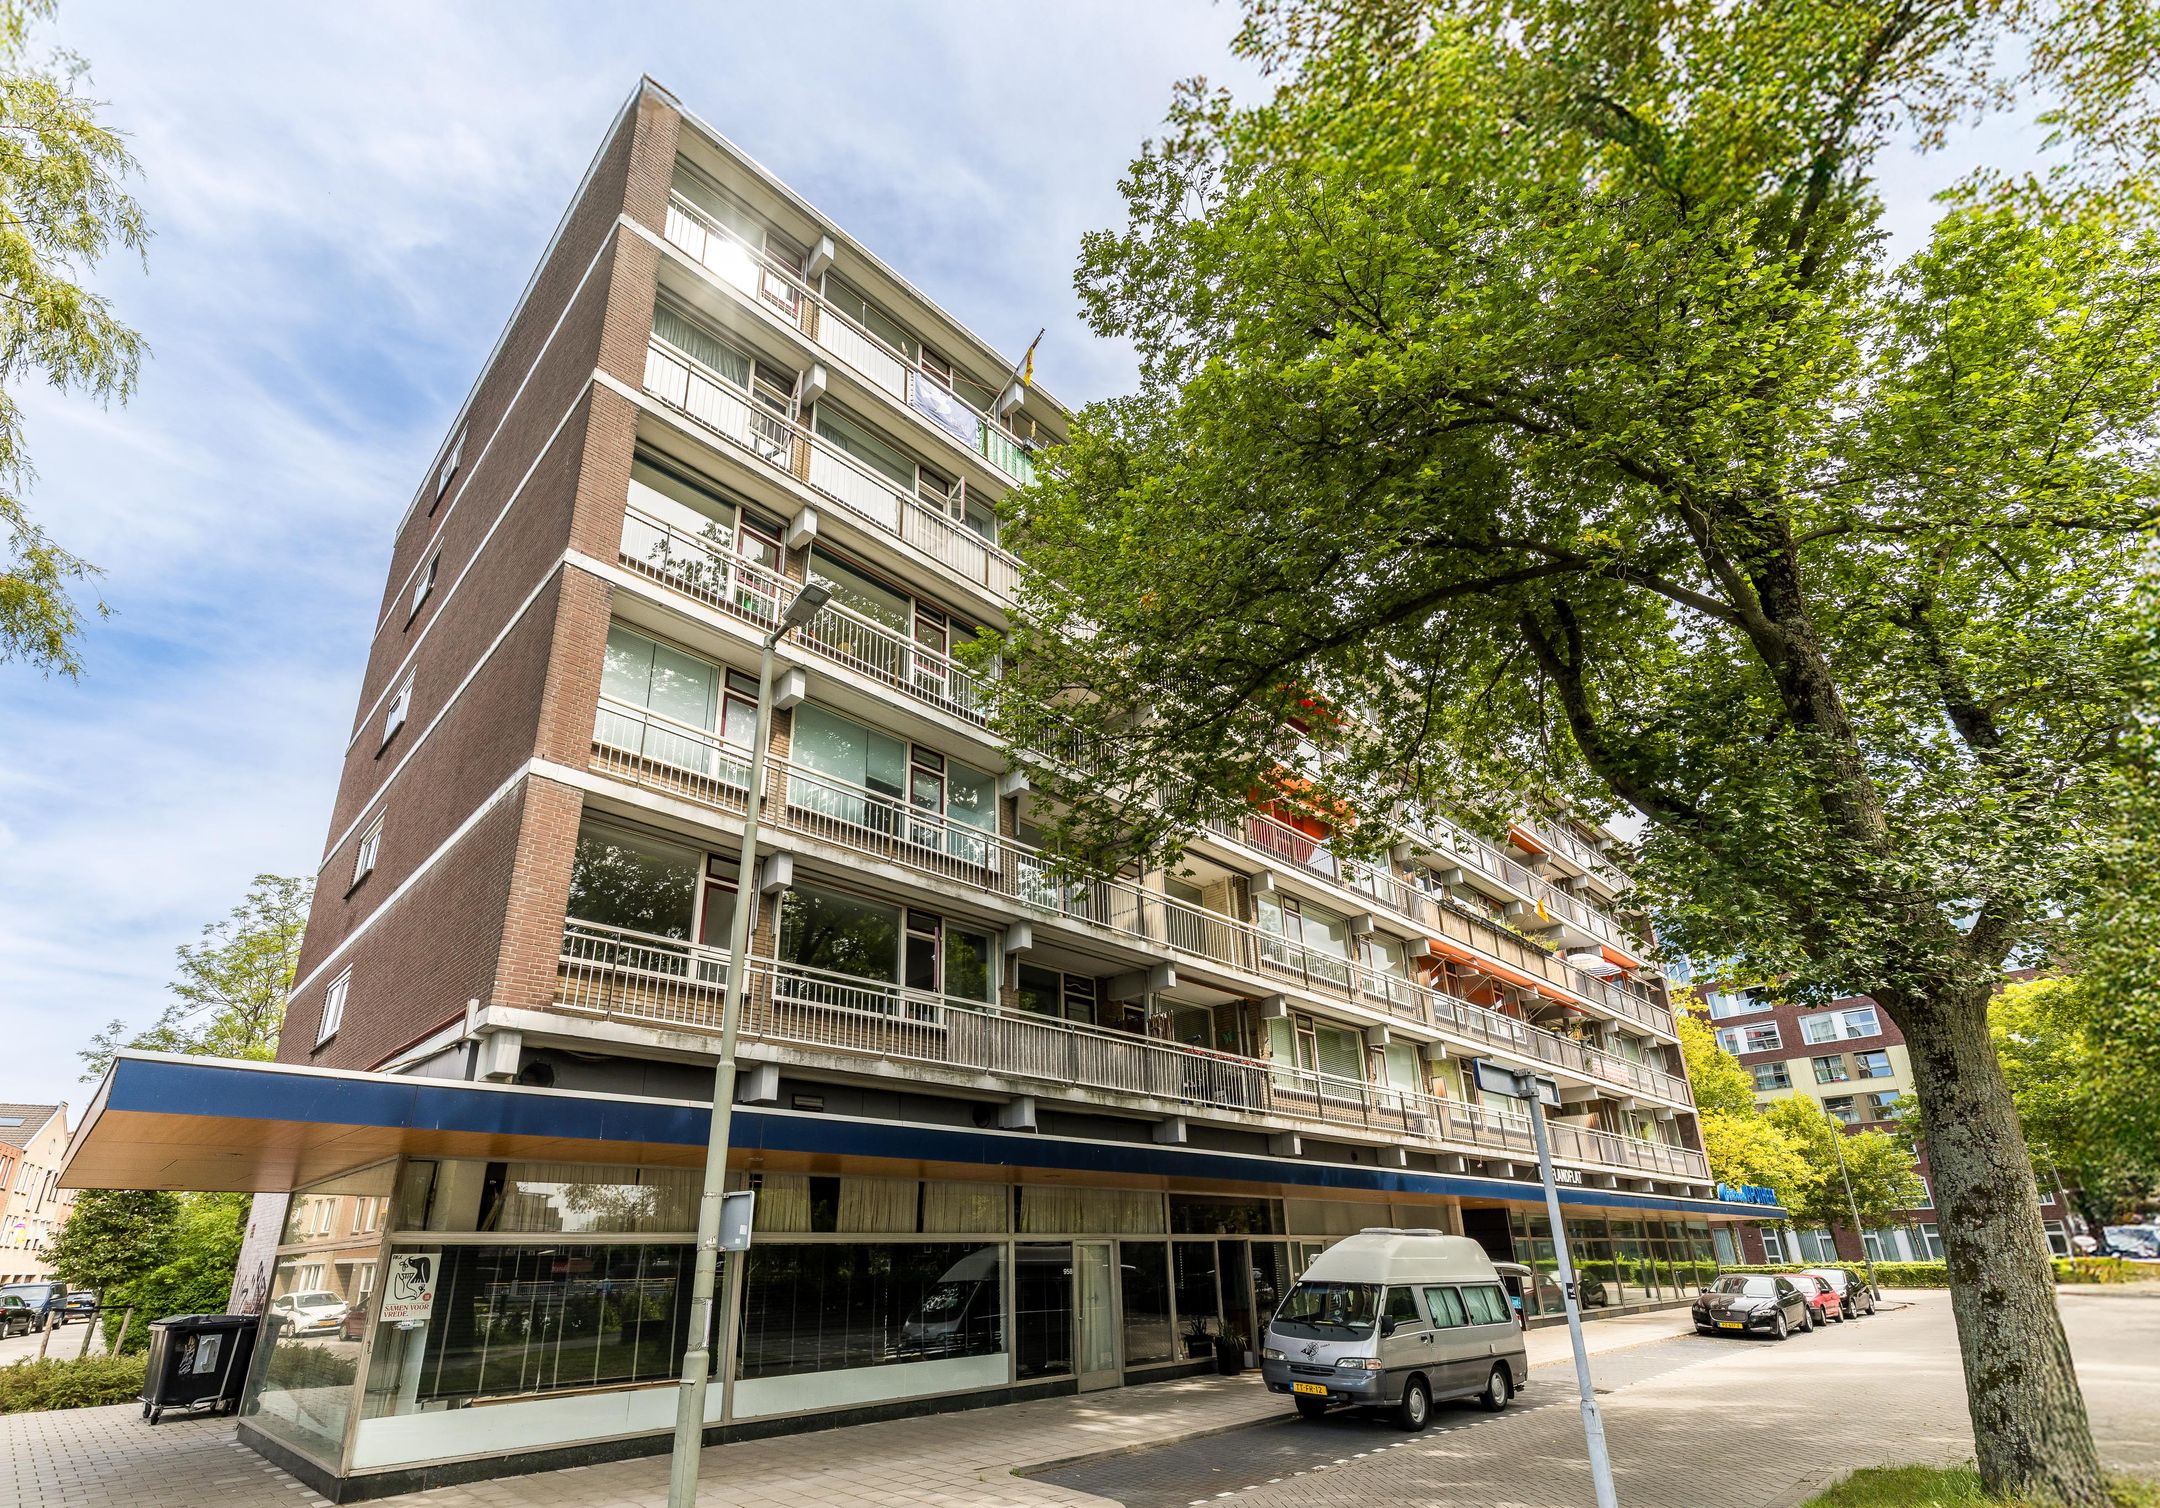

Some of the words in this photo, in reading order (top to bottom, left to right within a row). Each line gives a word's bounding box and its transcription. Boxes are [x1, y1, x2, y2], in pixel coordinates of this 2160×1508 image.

[384, 1304, 409, 1312] SAMEN
[410, 1303, 430, 1311] VOOR
[1295, 1383, 1323, 1394] TT-FR-12
